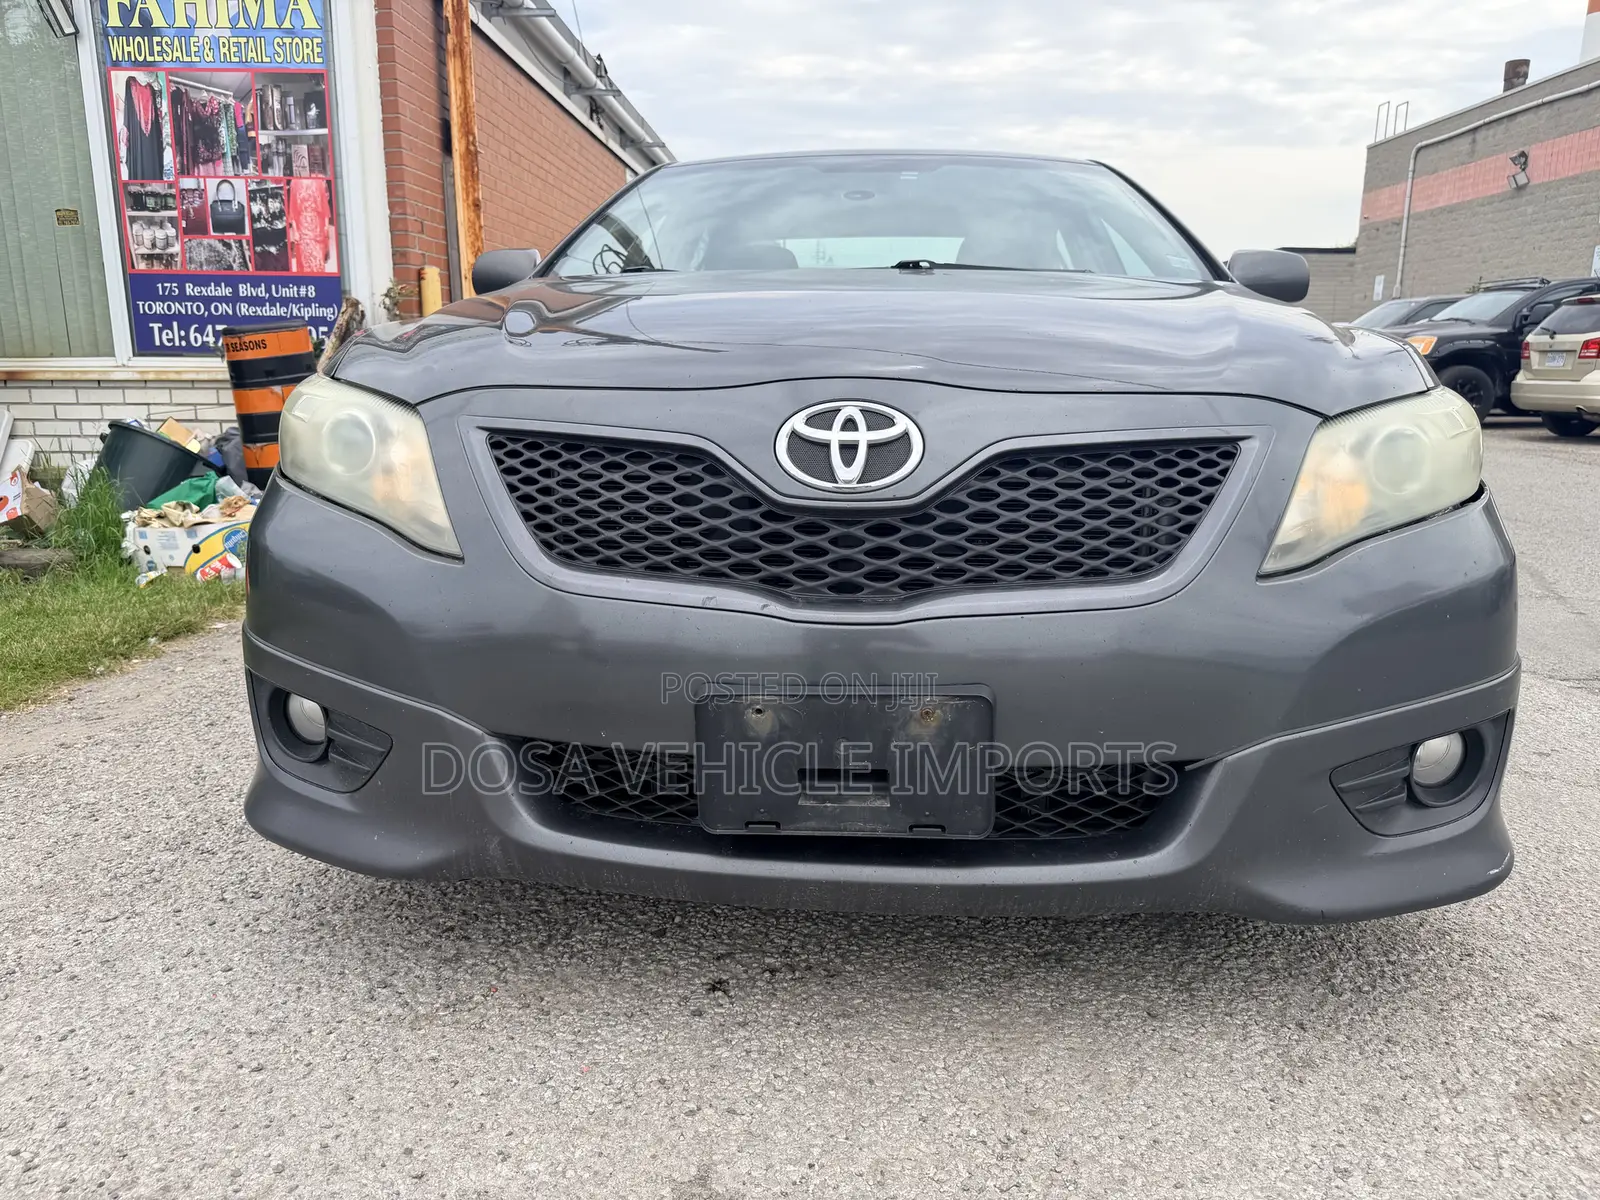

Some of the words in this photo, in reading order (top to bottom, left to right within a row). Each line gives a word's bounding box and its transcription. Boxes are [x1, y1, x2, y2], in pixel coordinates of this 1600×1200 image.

[105, 0, 323, 29] FAHIMA
[108, 35, 200, 63] WHOLESALE
[203, 36, 214, 63] &
[218, 36, 271, 63] RETAIL
[273, 36, 324, 64] STORE
[157, 283, 179, 296] 175
[185, 283, 232, 297] Rexdale
[238, 283, 269, 300] Blvd,
[137, 301, 208, 317] TORONTO,
[210, 303, 233, 316] ON
[236, 302, 338, 321] (Rexdale/Kipling)
[149, 321, 187, 347] Tel:
[231, 339, 267, 352] SEASONS
